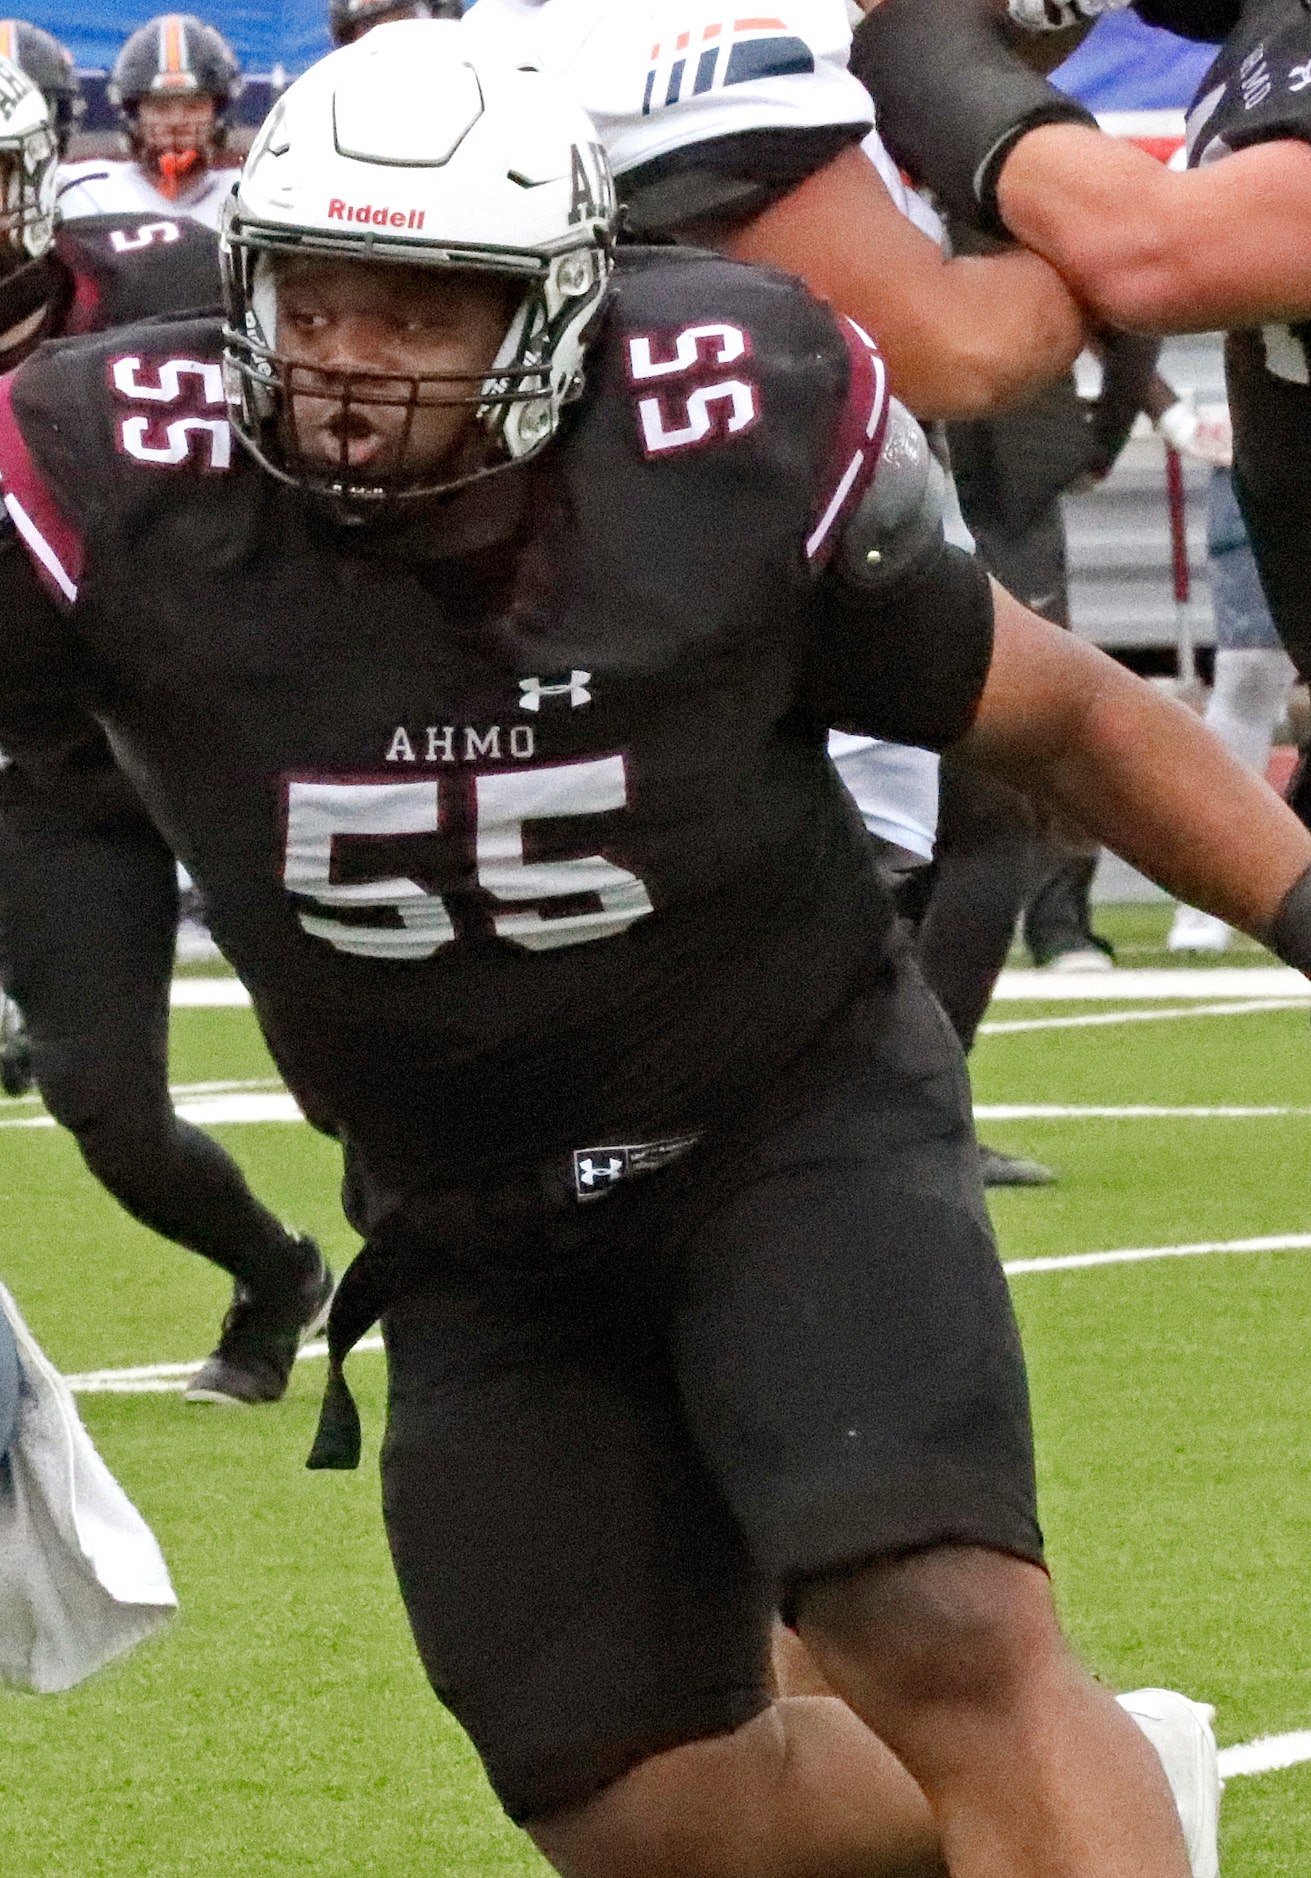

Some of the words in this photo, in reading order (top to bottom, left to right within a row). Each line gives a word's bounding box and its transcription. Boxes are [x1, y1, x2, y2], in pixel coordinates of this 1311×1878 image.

[109, 221, 180, 252] 5
[327, 198, 425, 229] Riddell
[111, 355, 232, 469] 55
[628, 323, 755, 453] 55
[386, 726, 534, 762] AHMO
[283, 754, 655, 961] 55
